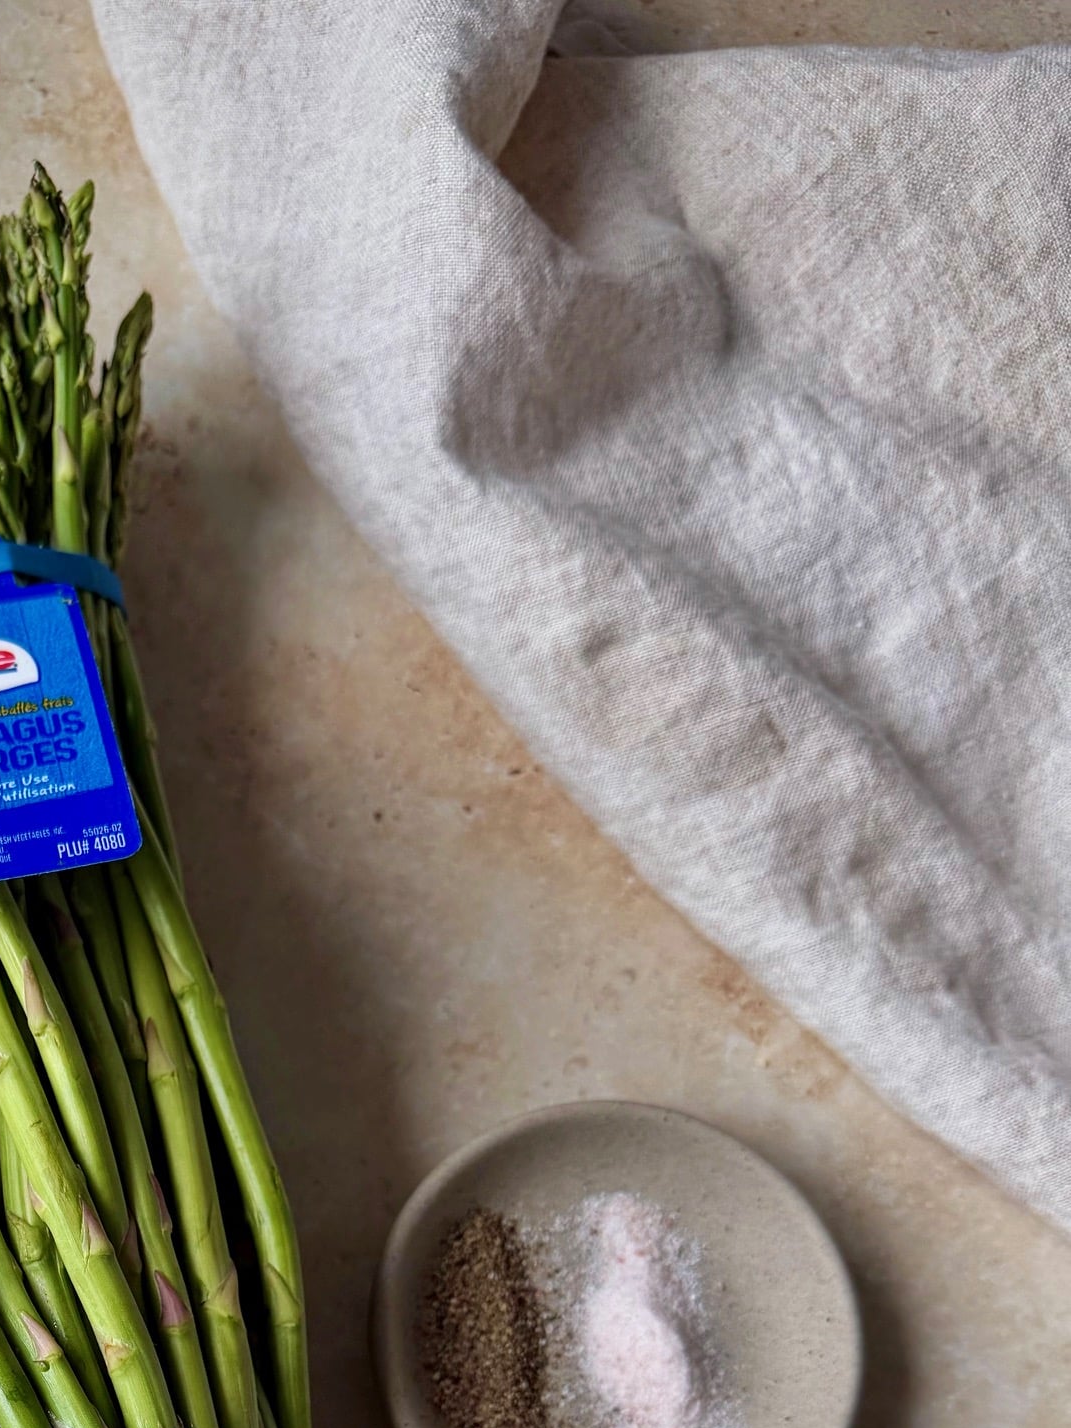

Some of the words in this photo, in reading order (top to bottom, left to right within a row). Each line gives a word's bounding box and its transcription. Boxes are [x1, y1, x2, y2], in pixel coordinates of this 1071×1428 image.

[42, 696, 74, 711] frais
[21, 773, 50, 787] Use
[13, 829, 51, 843] VEGETABLES
[82, 822, 123, 838] 55026-02
[57, 839, 90, 859] PLU#
[93, 832, 127, 852] 4080
